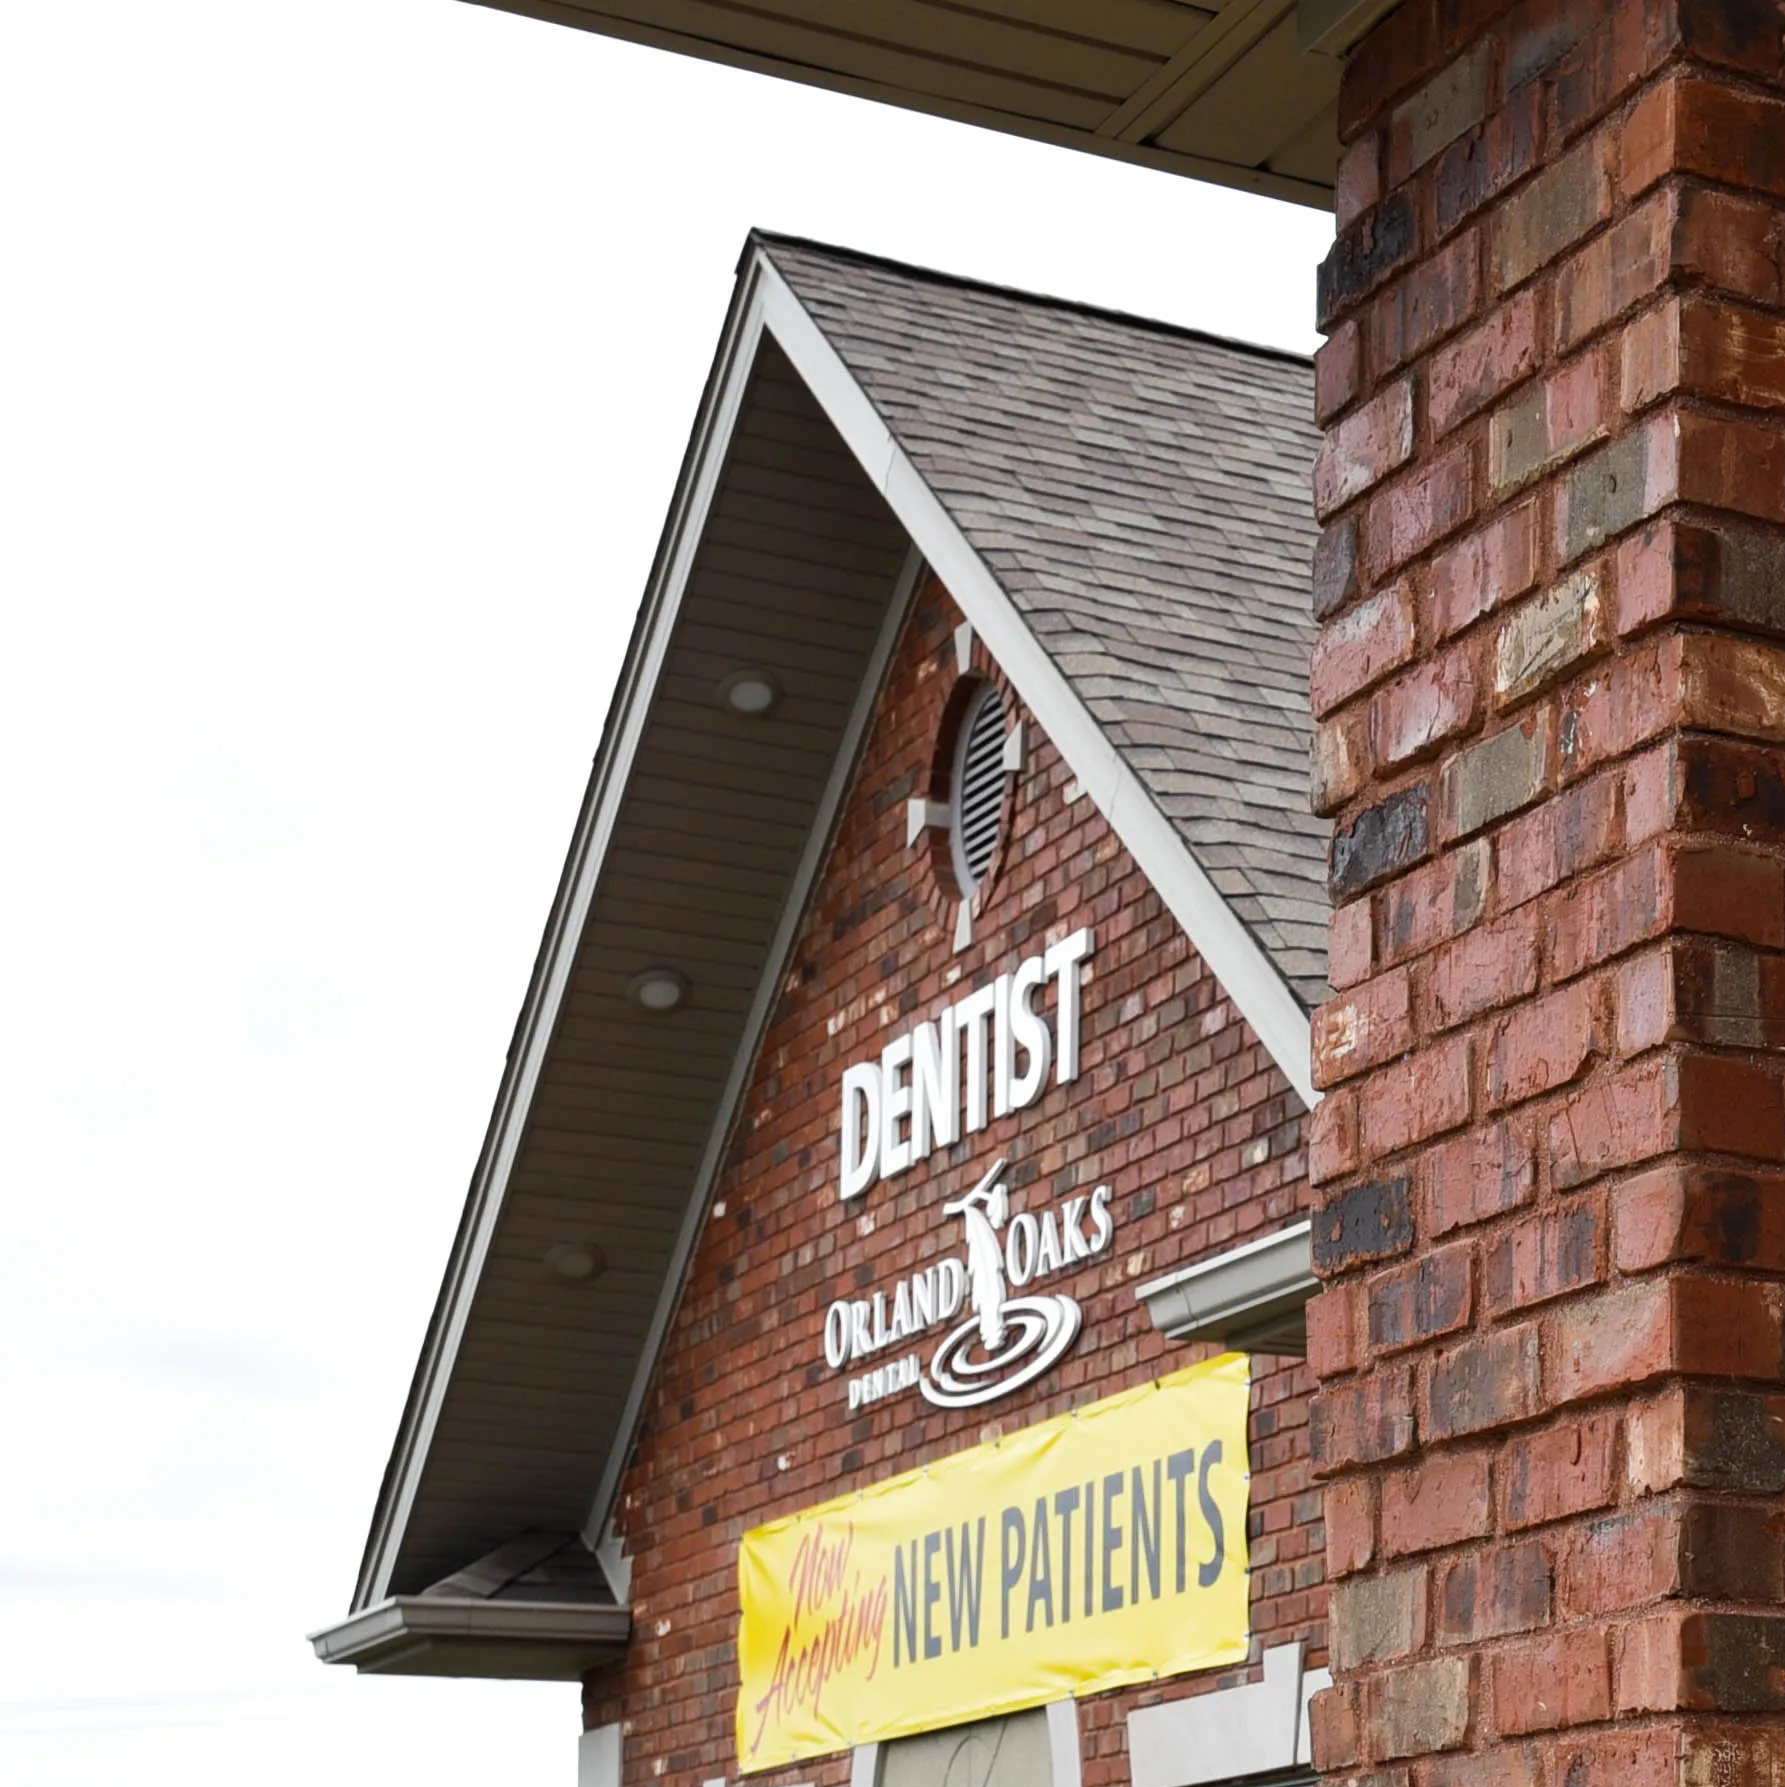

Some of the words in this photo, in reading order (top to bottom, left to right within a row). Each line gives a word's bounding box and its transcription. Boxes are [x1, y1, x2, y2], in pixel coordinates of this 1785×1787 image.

[839, 927, 1095, 1200] DENTIST
[824, 1257, 970, 1369] ORLAND
[1005, 1184, 1112, 1287] OAKS
[848, 1353, 921, 1411] DENTAL
[750, 1572, 889, 1757] Accepting
[893, 1516, 987, 1669] NEW
[1000, 1439, 1226, 1640] PATIENTS
[789, 1520, 853, 1632] Now
